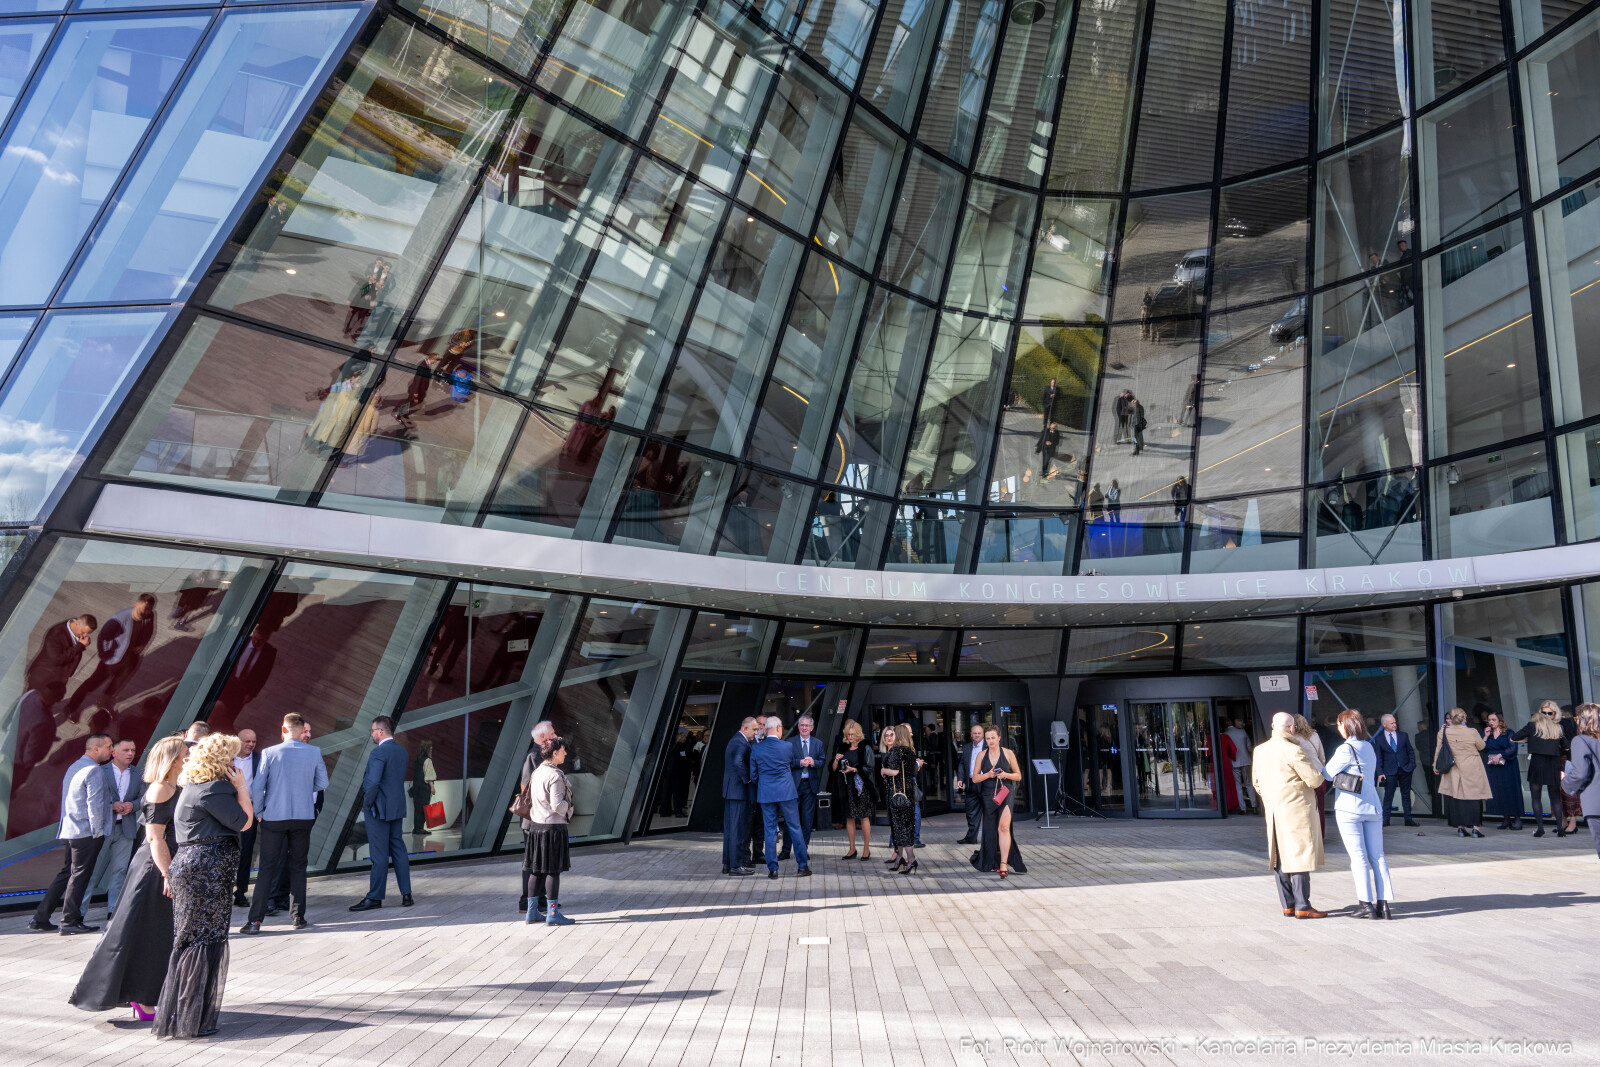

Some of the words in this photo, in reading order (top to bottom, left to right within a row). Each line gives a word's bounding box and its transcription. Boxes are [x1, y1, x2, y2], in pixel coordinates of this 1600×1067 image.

[776, 571, 926, 597] CENTRUM
[959, 581, 1187, 599] KONGRESOWE
[1222, 578, 1268, 596] ICE
[1305, 565, 1469, 593] KRAKÓW
[1269, 679, 1279, 687] 17
